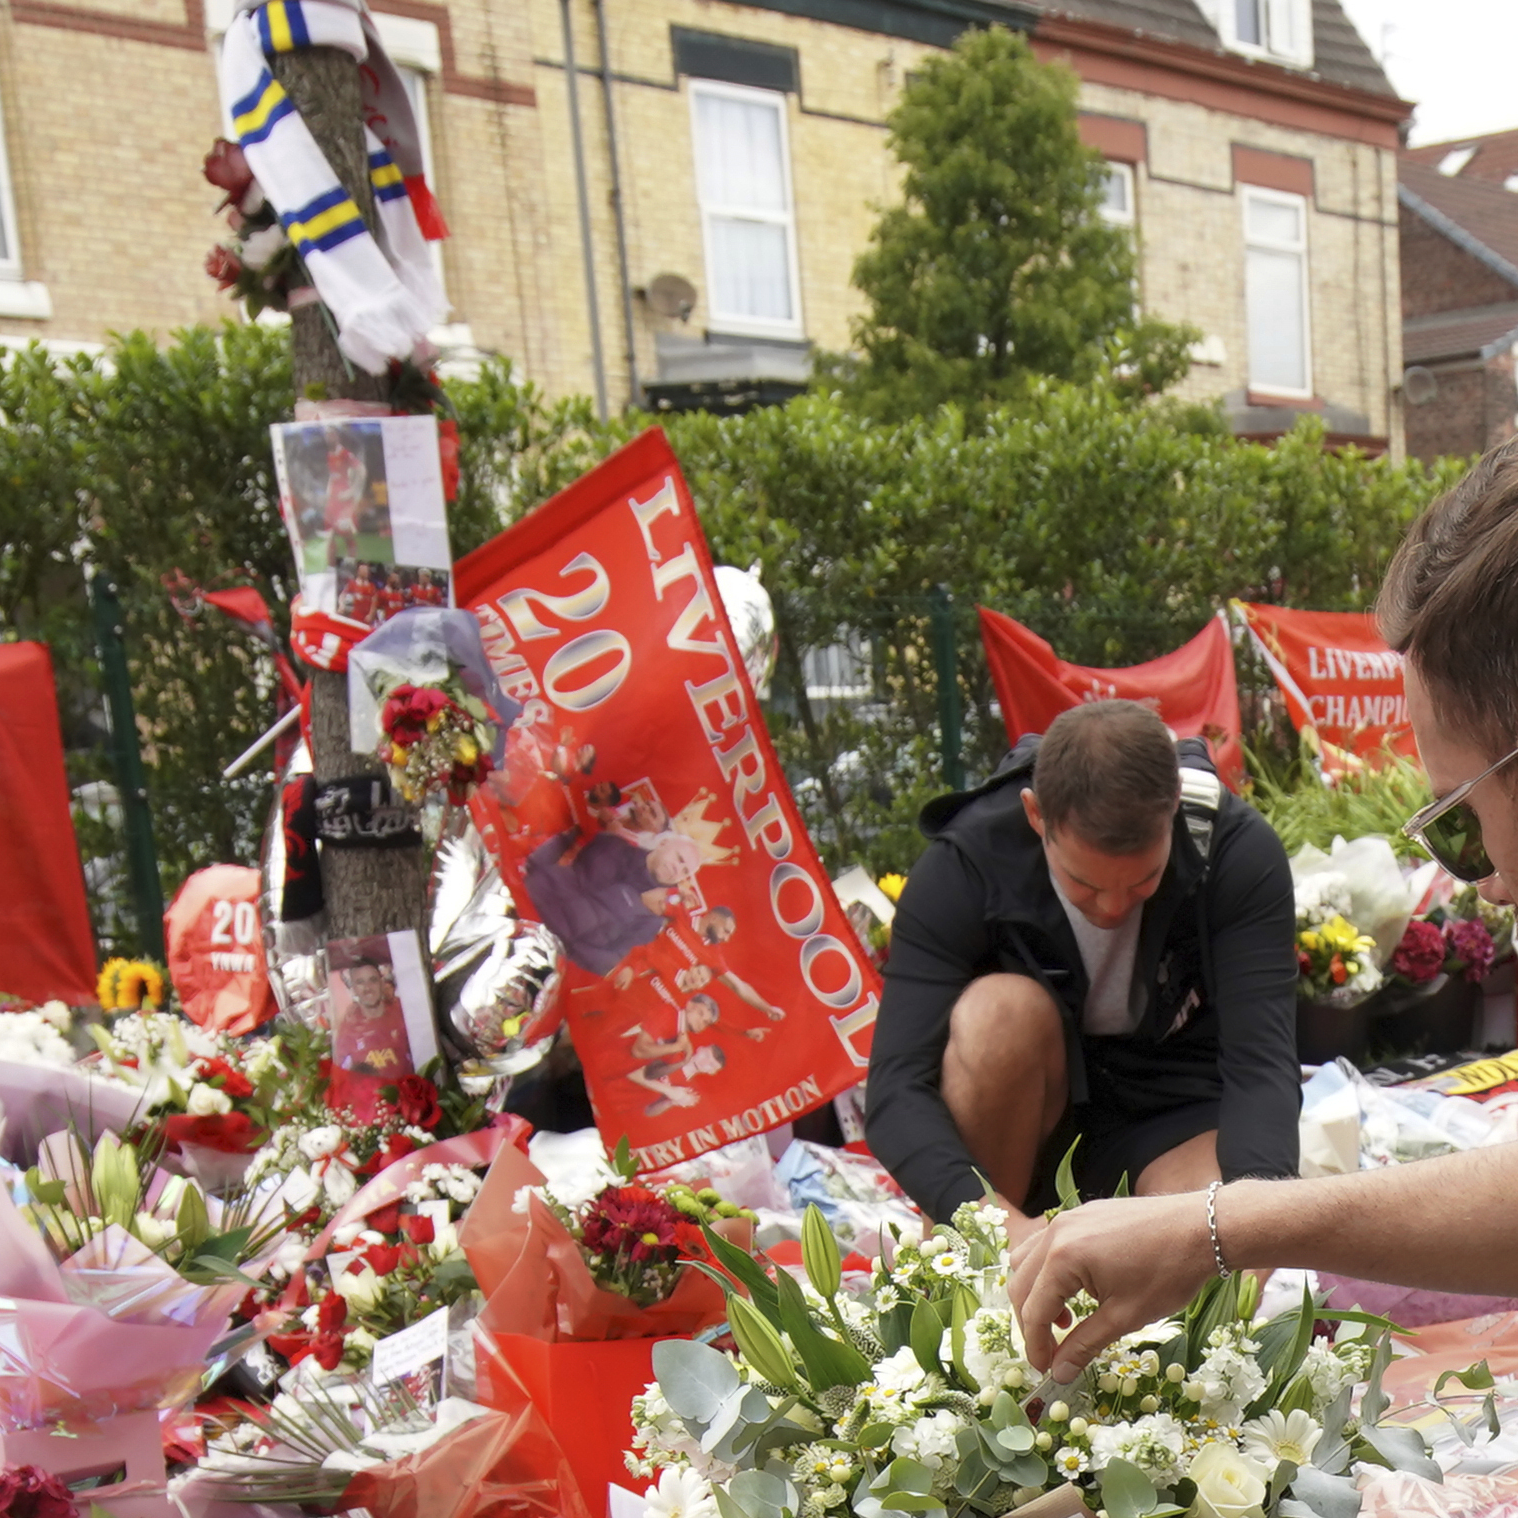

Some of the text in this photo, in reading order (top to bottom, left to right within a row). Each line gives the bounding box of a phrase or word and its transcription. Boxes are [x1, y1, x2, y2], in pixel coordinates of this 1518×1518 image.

[497, 549, 633, 712] 20
[210, 899, 255, 945] 20
[687, 1123, 722, 1154] IN
[718, 1074, 824, 1141] MOTION
